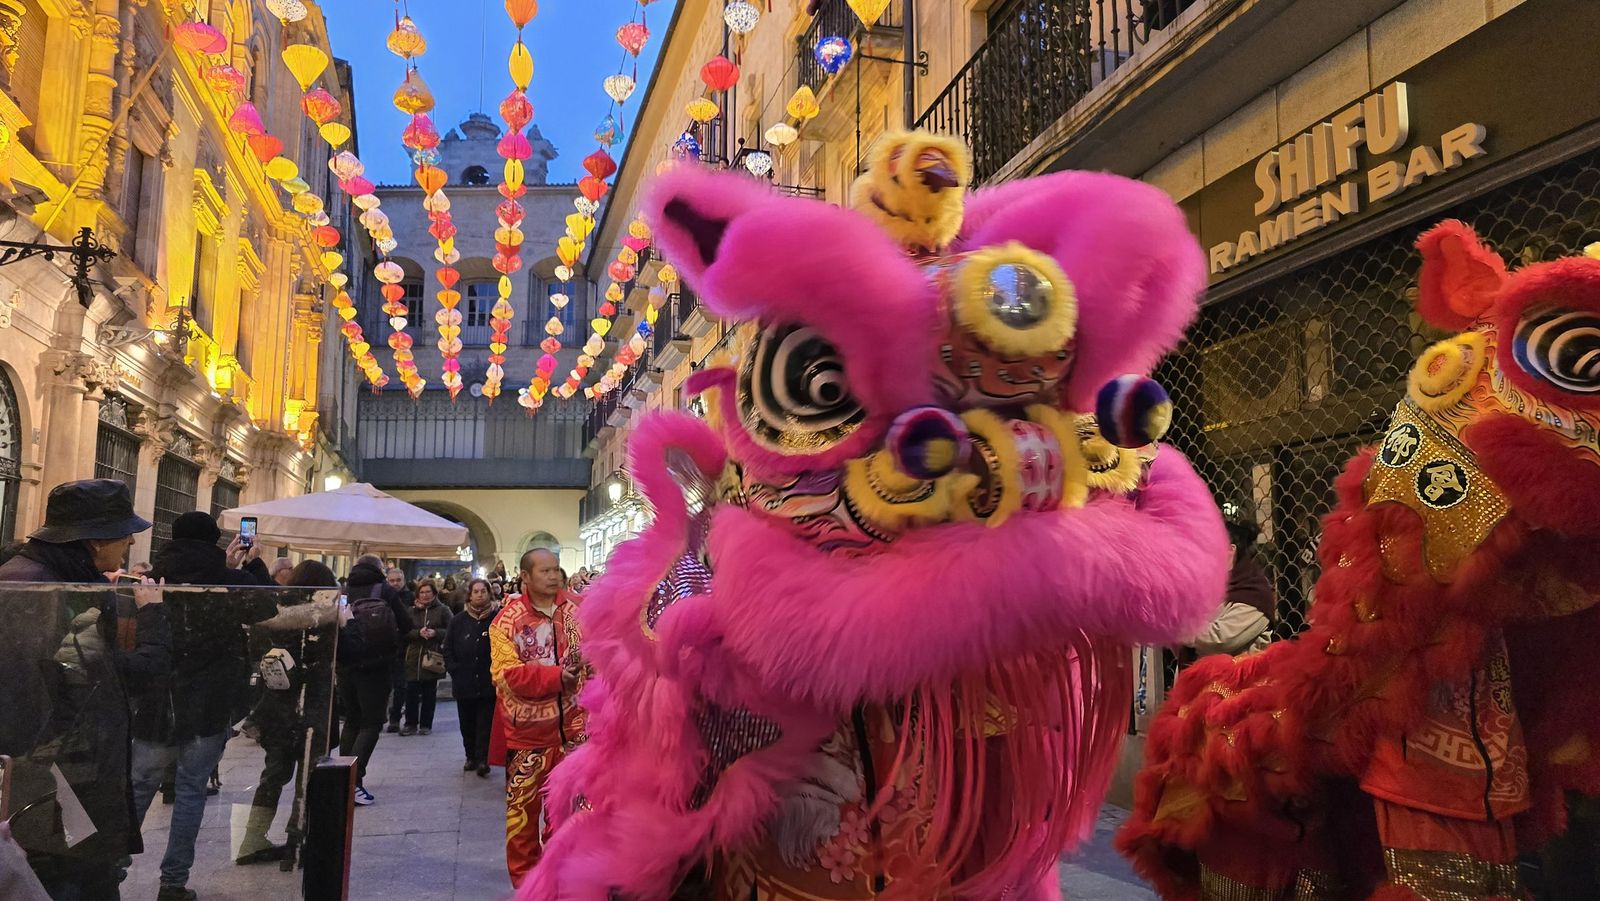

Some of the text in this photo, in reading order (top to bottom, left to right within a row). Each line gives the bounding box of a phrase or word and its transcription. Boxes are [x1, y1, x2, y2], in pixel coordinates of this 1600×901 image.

[1210, 122, 1487, 274] RAMEN BAR
[1255, 81, 1409, 216] SHIFU
